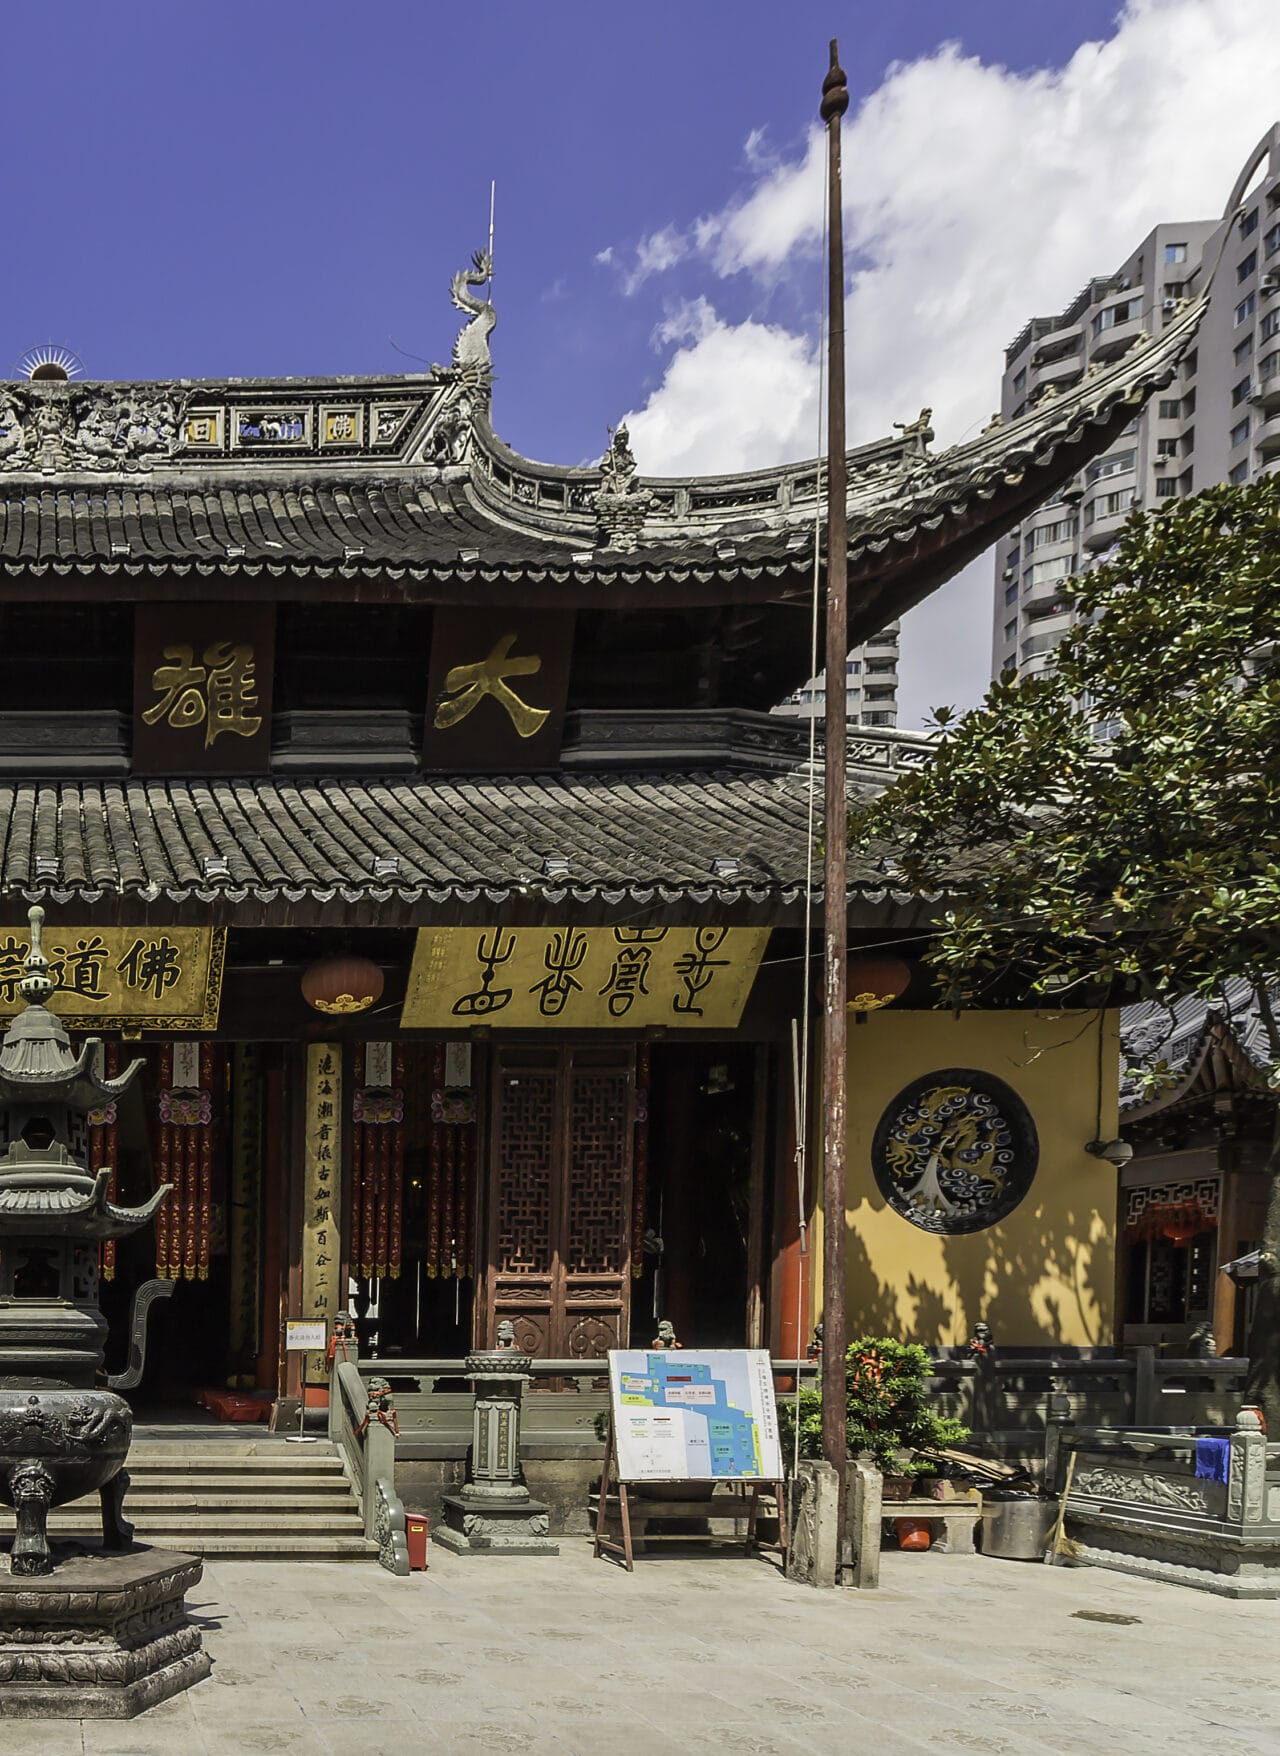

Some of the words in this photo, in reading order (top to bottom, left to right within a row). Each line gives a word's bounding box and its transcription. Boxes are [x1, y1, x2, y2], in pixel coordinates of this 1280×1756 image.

[193, 417, 211, 441] 日
[141, 641, 262, 751] 雄
[433, 632, 551, 738] 大
